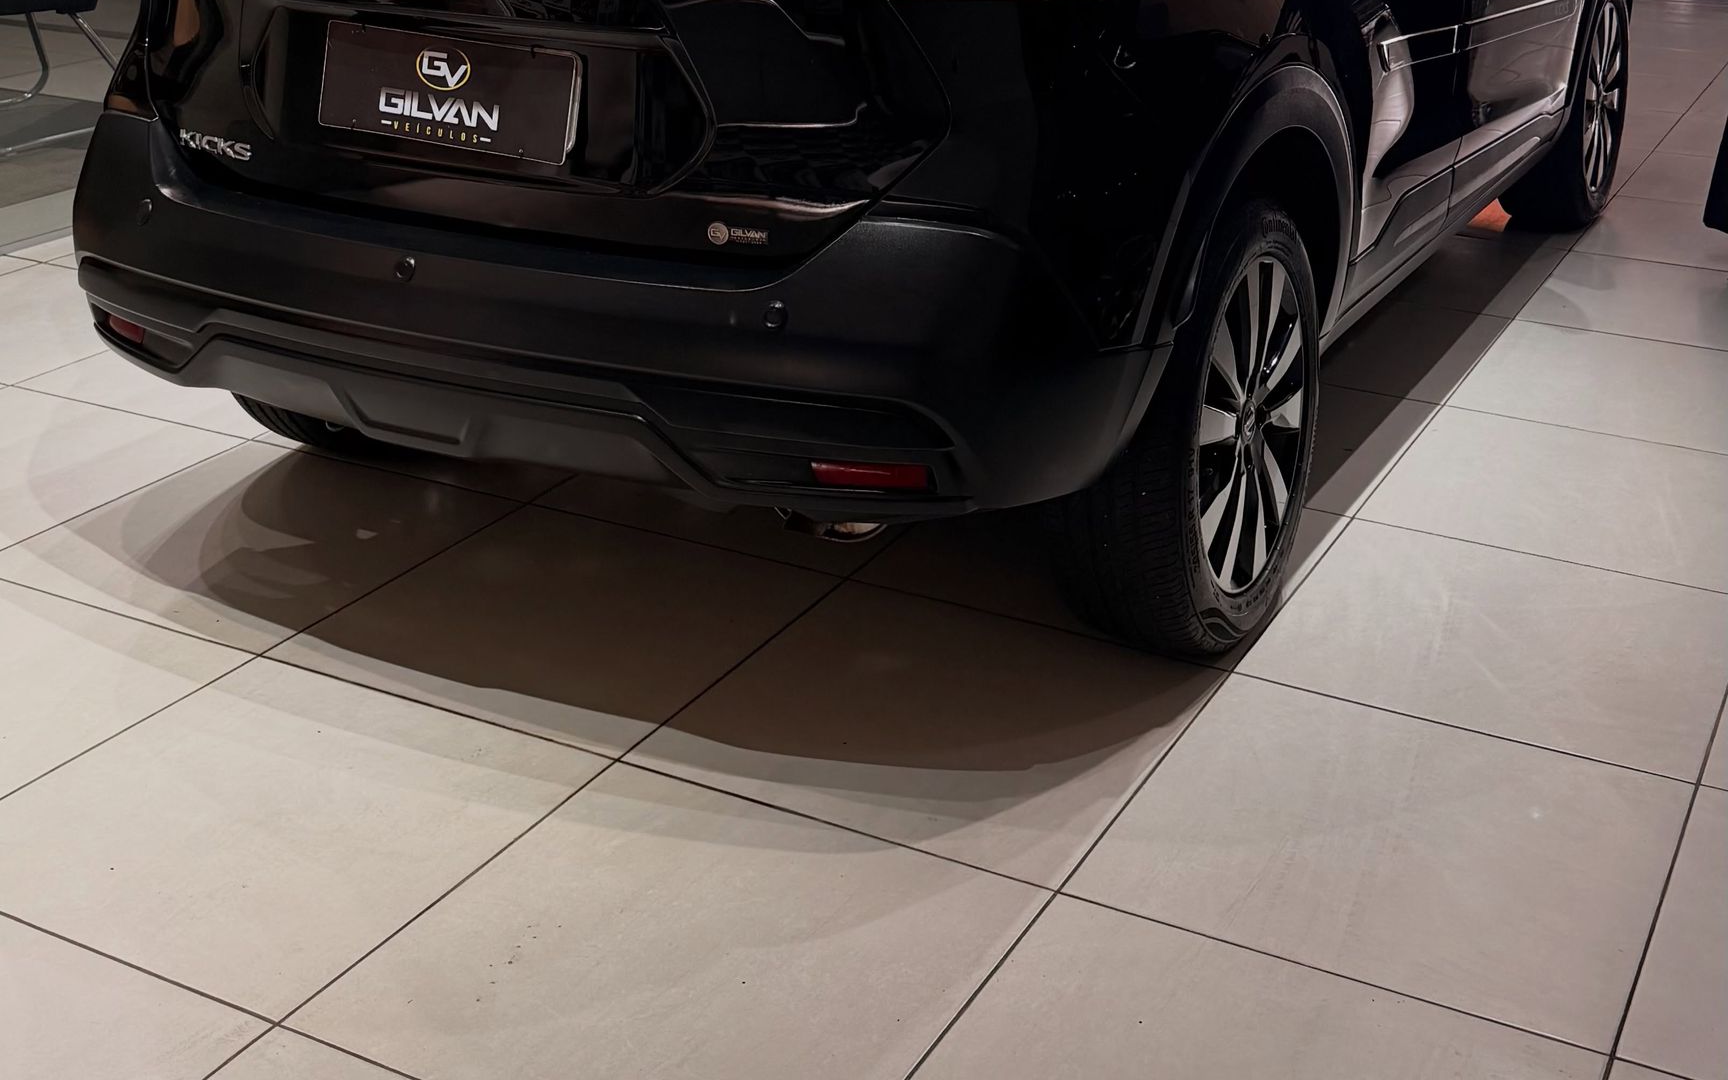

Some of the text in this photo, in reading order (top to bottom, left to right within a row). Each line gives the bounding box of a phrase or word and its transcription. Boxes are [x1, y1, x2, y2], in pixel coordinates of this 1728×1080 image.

[421, 50, 468, 88] GV
[379, 86, 500, 131] GILVAN
[180, 128, 252, 160] KICKS
[730, 228, 767, 238] GILVAN
